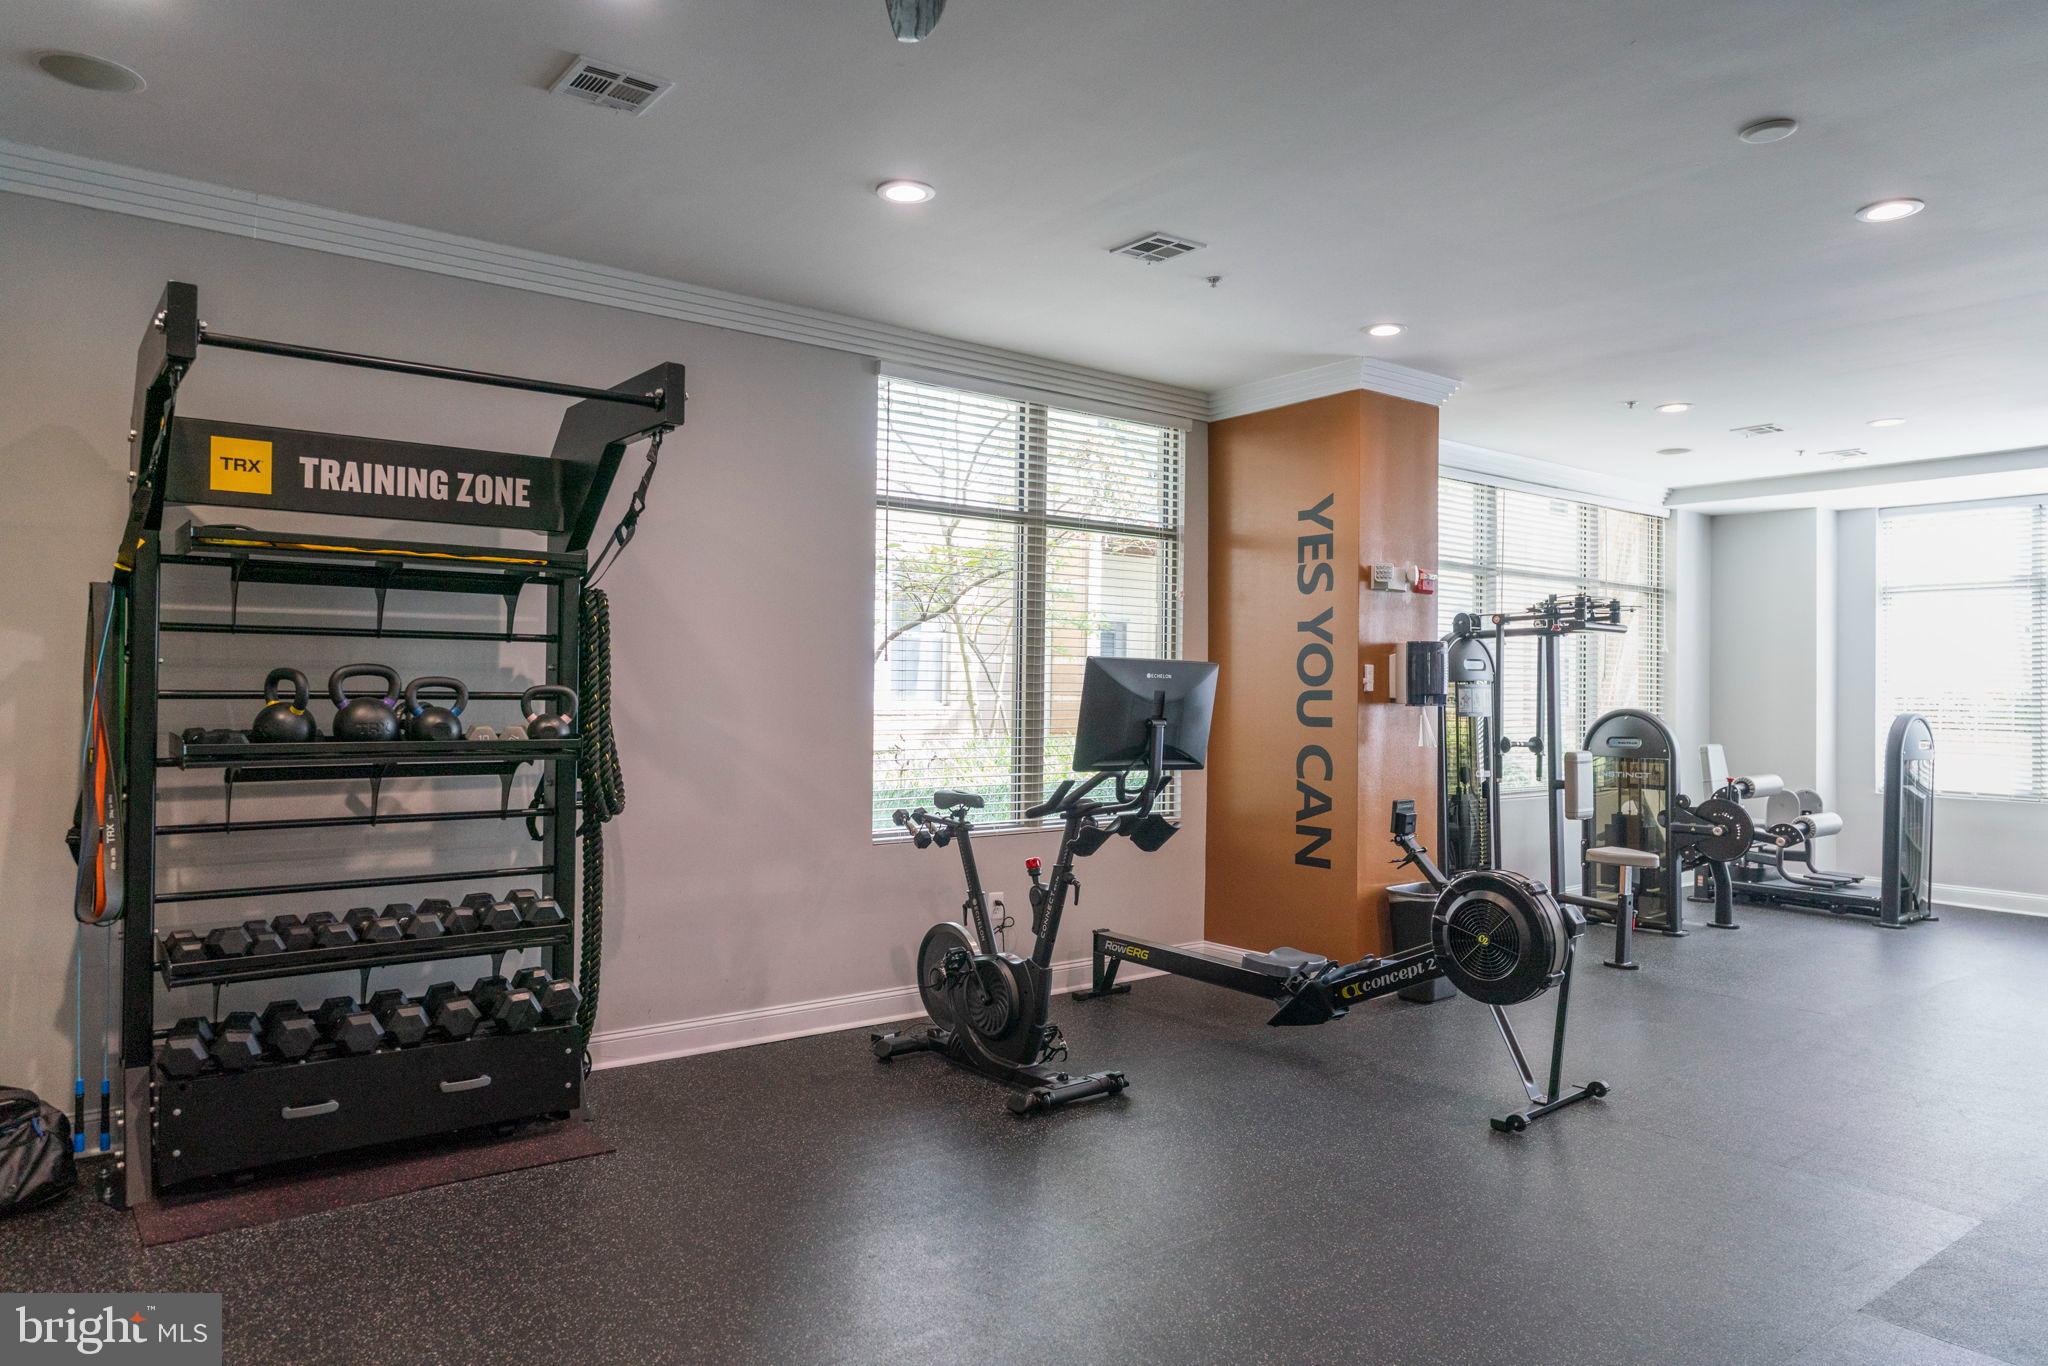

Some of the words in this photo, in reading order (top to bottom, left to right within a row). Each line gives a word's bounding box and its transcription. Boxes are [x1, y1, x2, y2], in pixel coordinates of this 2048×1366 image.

[219, 456, 261, 473] TRX
[299, 456, 449, 500] TRAINING
[456, 472, 531, 508] ZONE
[1297, 492, 1335, 595] YES
[1296, 606, 1334, 728] YOU
[1600, 771, 1652, 779] NSTINCT
[1295, 744, 1334, 869] CAN
[106, 824, 116, 844] TRX
[1041, 890, 1055, 939] CONNECT
[1362, 961, 1425, 991] concept
[1426, 958, 1437, 971] 2
